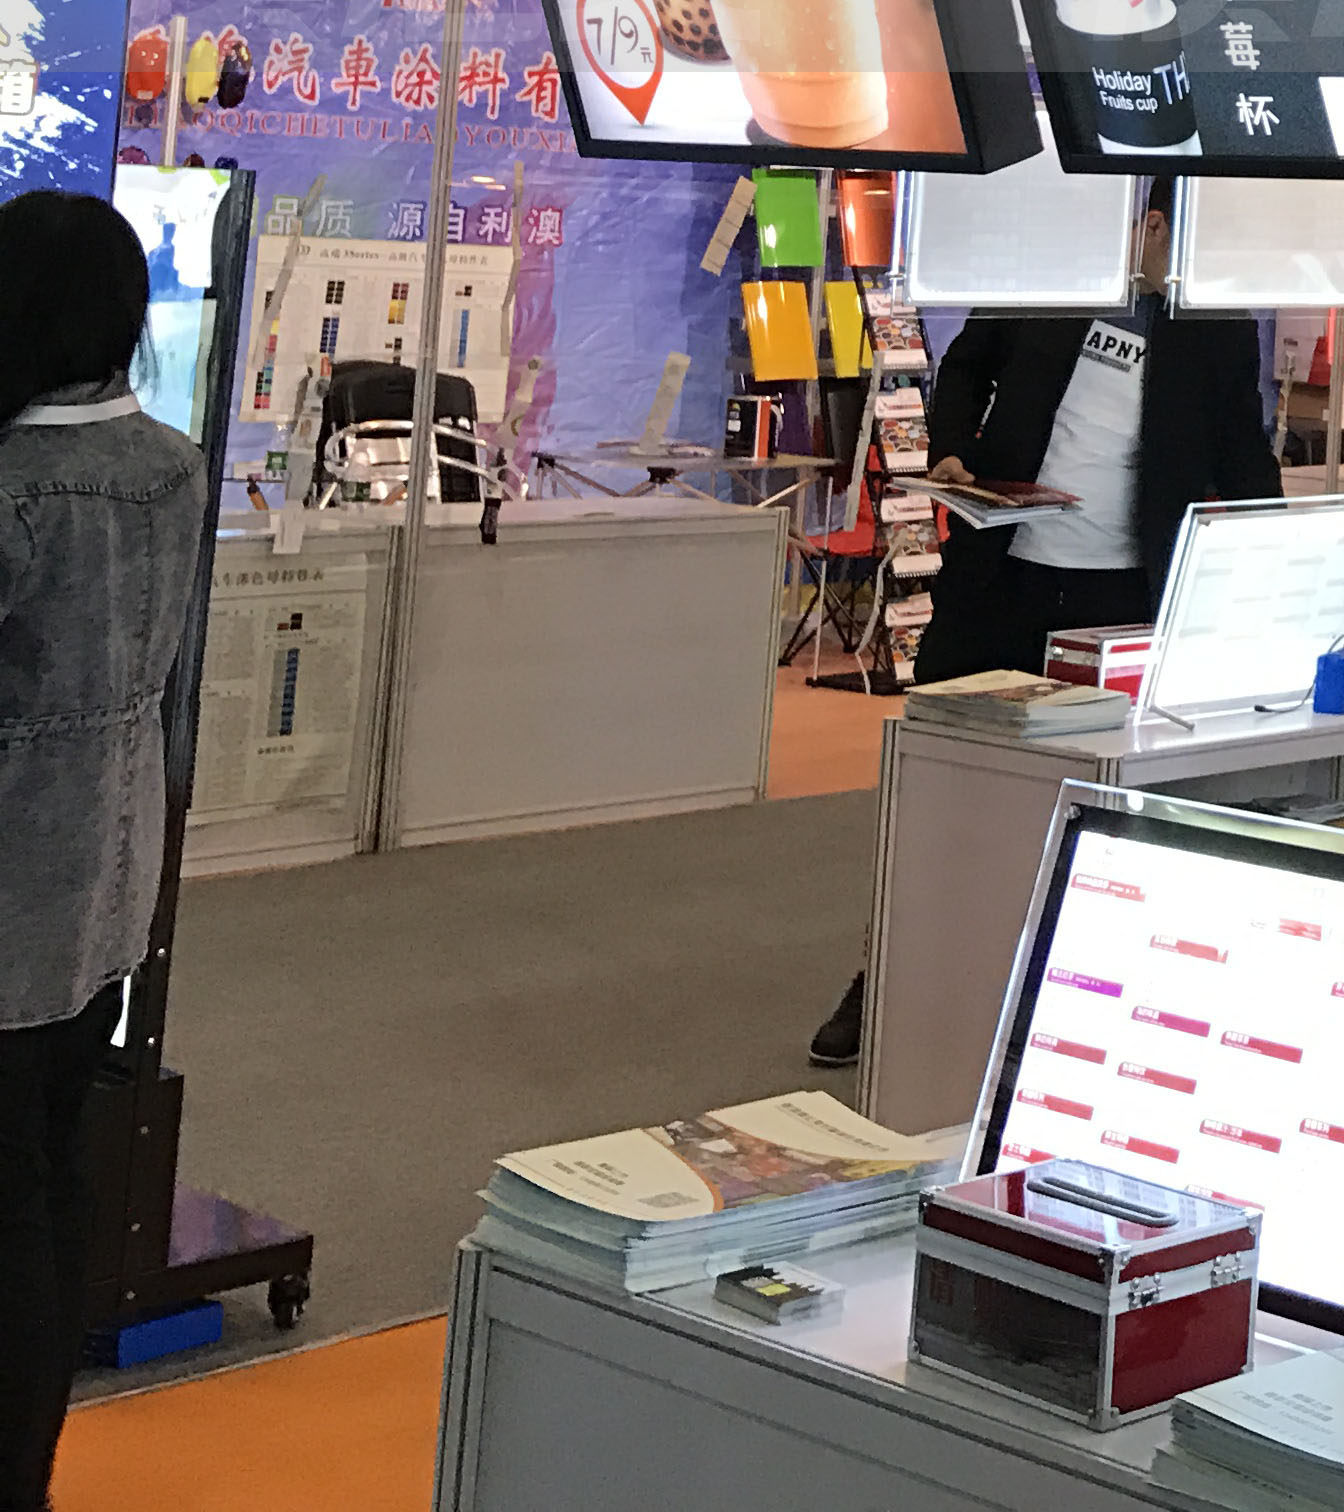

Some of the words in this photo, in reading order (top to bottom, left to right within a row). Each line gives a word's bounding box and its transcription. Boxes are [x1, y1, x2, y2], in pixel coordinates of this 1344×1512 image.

[1091, 66, 1153, 95] Holiday
[1098, 89, 1133, 113] Fruits
[1135, 94, 1160, 115] cup
